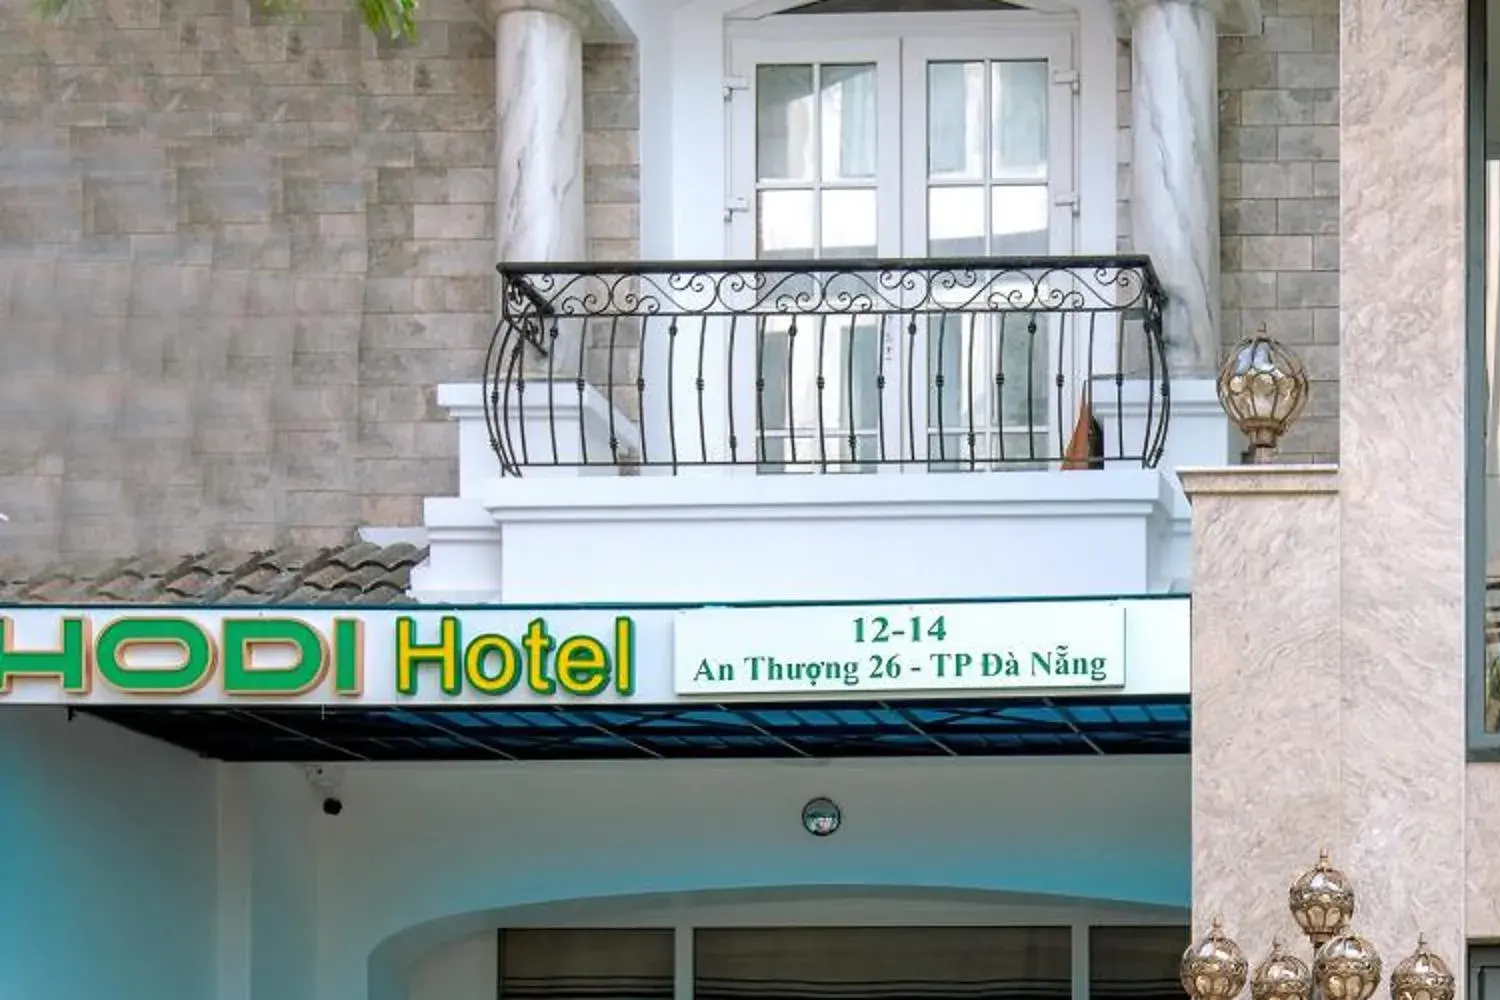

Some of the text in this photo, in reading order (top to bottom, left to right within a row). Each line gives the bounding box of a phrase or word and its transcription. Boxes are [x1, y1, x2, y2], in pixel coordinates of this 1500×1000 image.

[853, 615, 947, 642] 12-14
[0, 616, 633, 696] HODI Hotel
[693, 657, 735, 681] An
[743, 655, 859, 686] Thượng
[869, 653, 901, 679] 26
[930, 653, 972, 677] TP
[981, 651, 1020, 677] Đà
[1031, 645, 1107, 681] Nẵng
